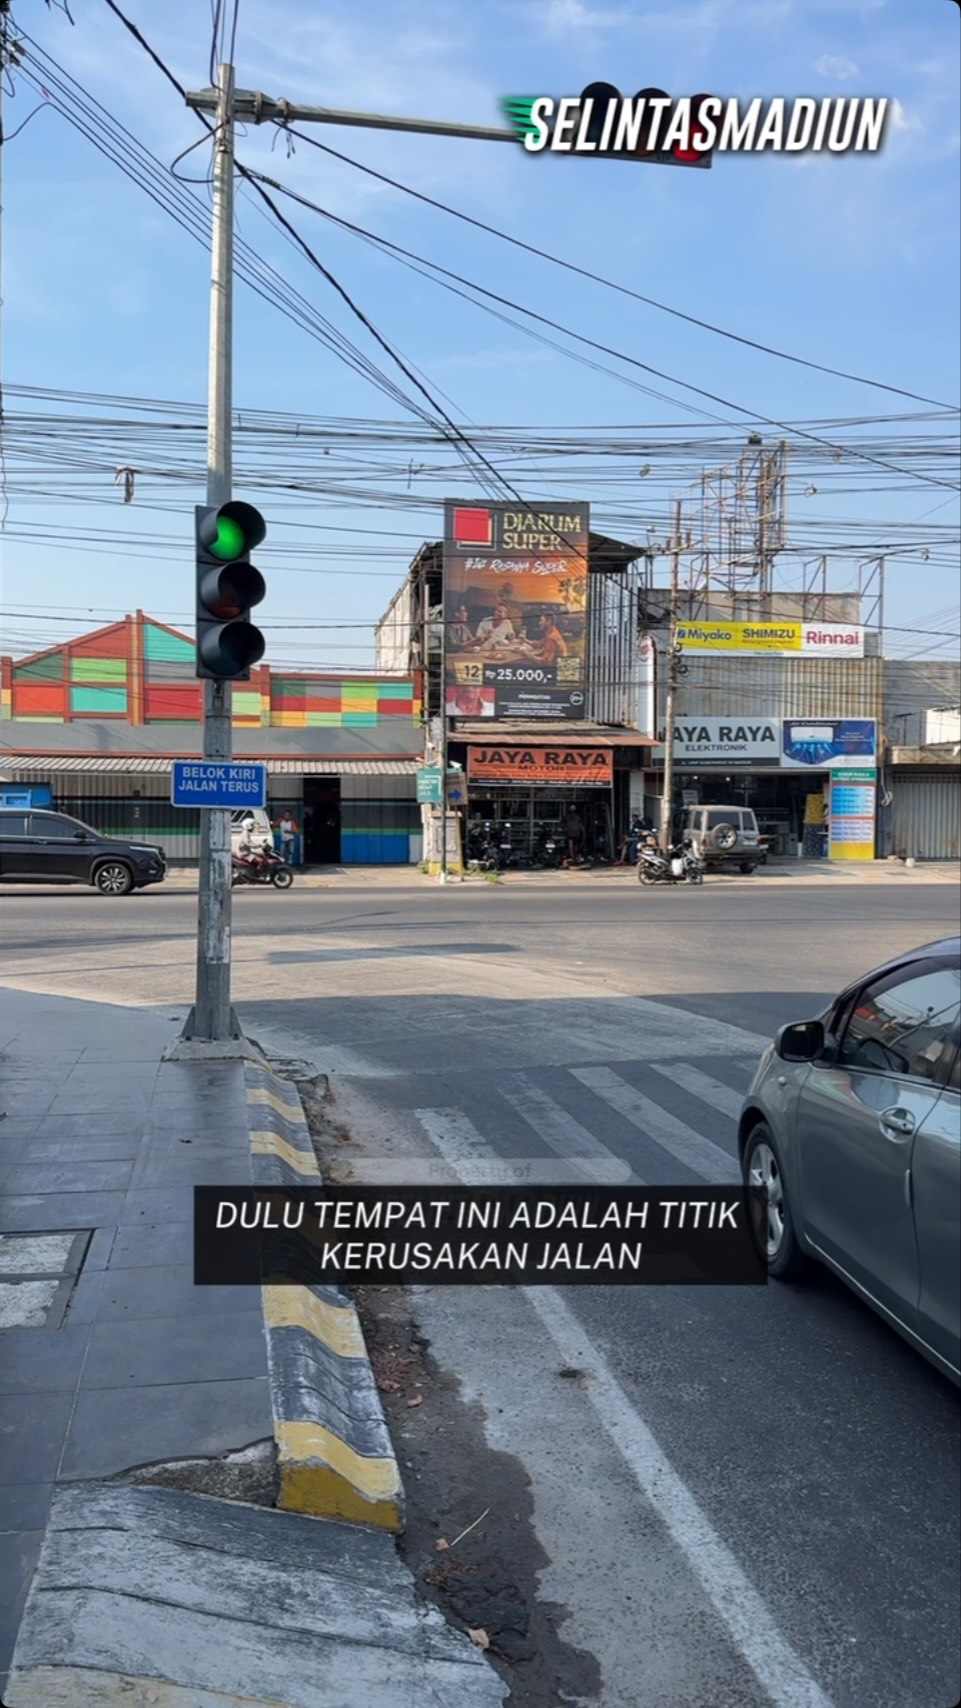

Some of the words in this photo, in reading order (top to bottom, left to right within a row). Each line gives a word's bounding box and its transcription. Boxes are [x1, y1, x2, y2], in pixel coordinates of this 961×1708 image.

[503, 512, 580, 532] DJARUM
[502, 533, 562, 551] SUPER
[687, 628, 732, 642] Miyako
[742, 627, 795, 639] SHIMIZU
[806, 631, 859, 645] Rinnai
[464, 665, 480, 678] 12
[497, 668, 552, 683] 25.000,-
[718, 726, 776, 742] RAYA
[685, 744, 748, 752] ELEKTRONIK
[473, 750, 536, 763] JAYA
[544, 752, 608, 766] RAYA
[182, 766, 226, 779] BELOK
[229, 768, 256, 780] KIRI
[178, 780, 217, 791] JALAN
[220, 781, 260, 793] TERUS
